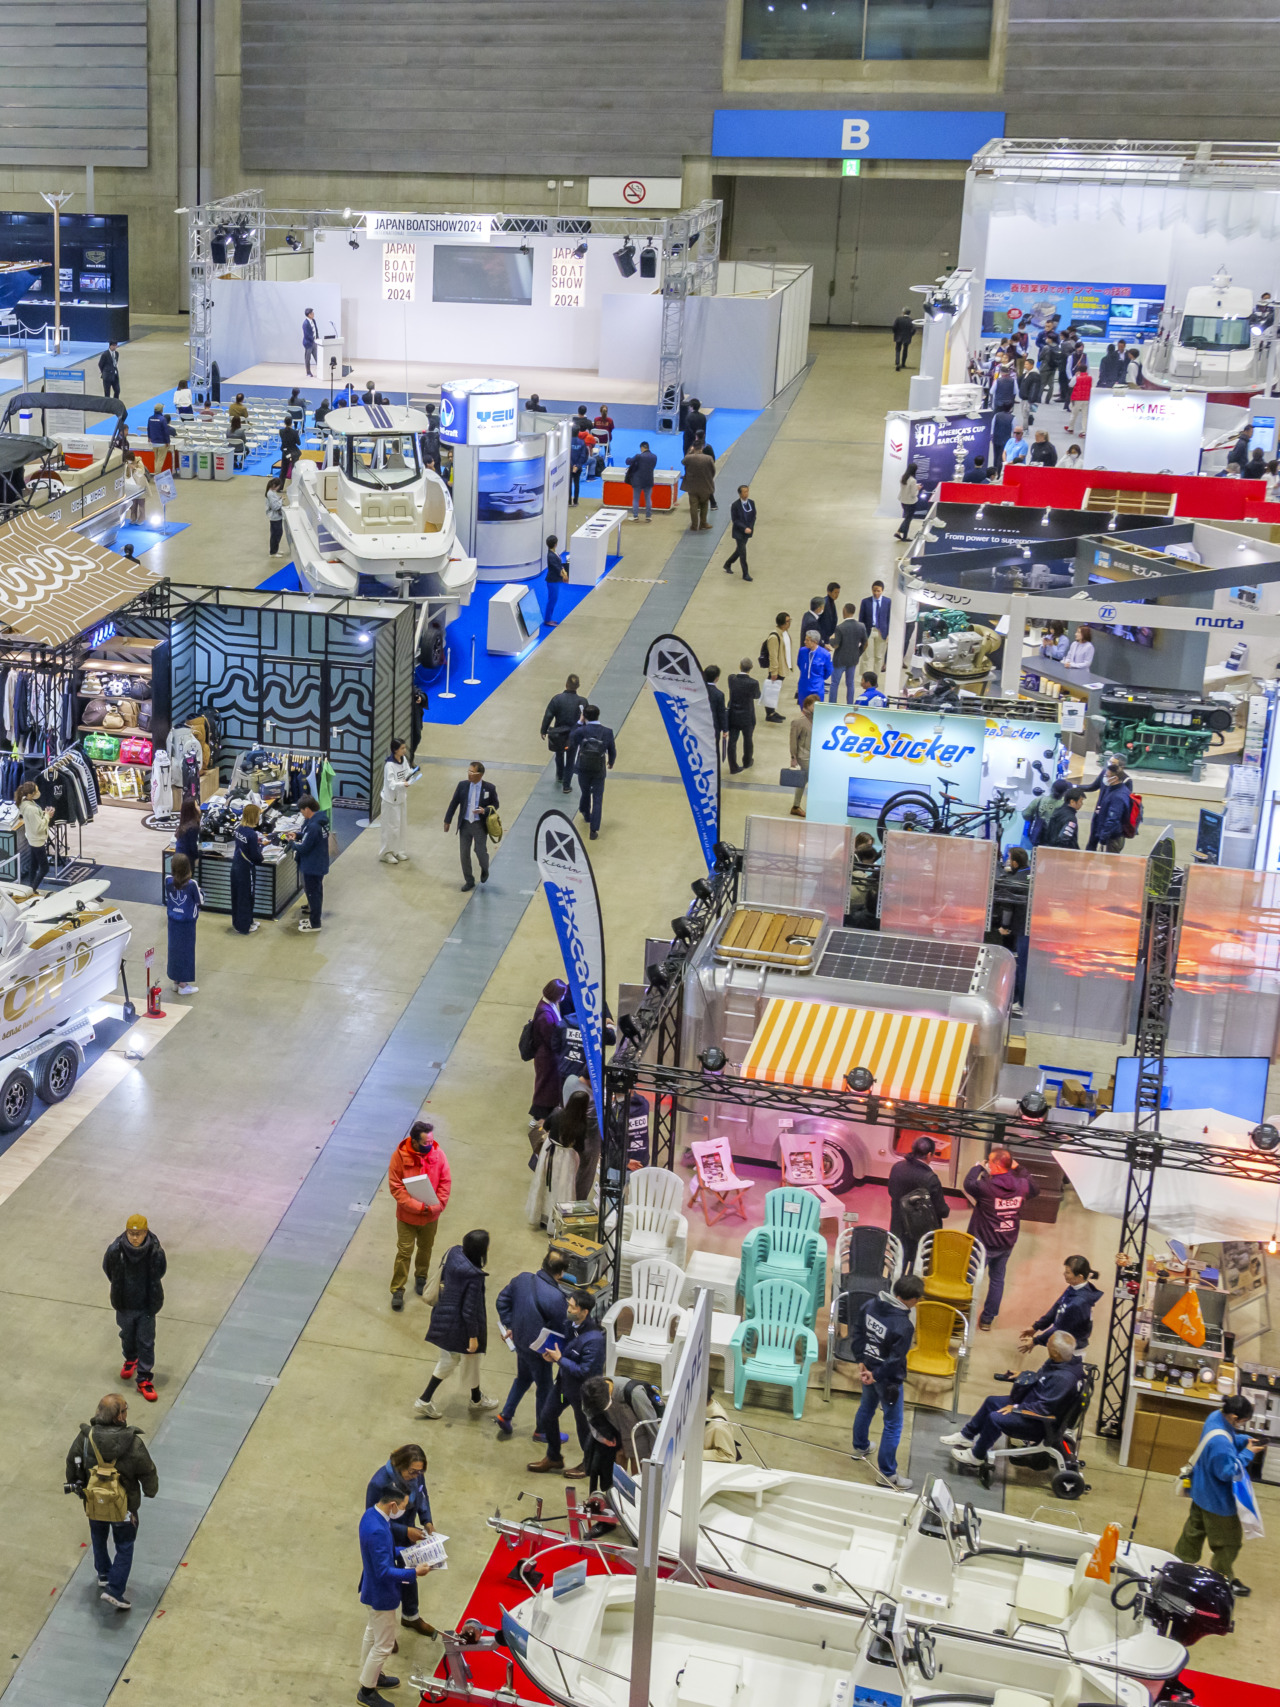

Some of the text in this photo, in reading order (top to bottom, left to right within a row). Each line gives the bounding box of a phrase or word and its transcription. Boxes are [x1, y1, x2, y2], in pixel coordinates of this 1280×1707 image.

[840, 118, 870, 151] B
[385, 243, 415, 254] JAPAN
[384, 260, 415, 271] BOAT
[552, 265, 584, 277] BOAT
[384, 272, 415, 283] SHOW
[551, 277, 583, 289] SHOW
[387, 288, 411, 300] 2024
[554, 294, 579, 307] 2024
[972, 425, 986, 433] CUP
[944, 533, 965, 541] From
[965, 535, 989, 543] power
[922, 588, 972, 606] ミズノマリン
[821, 725, 976, 763] SeaSucker
[1, 1025, 22, 1043] sense
[22, 1017, 34, 1031] not
[998, 1198, 1018, 1207] X-ECO
